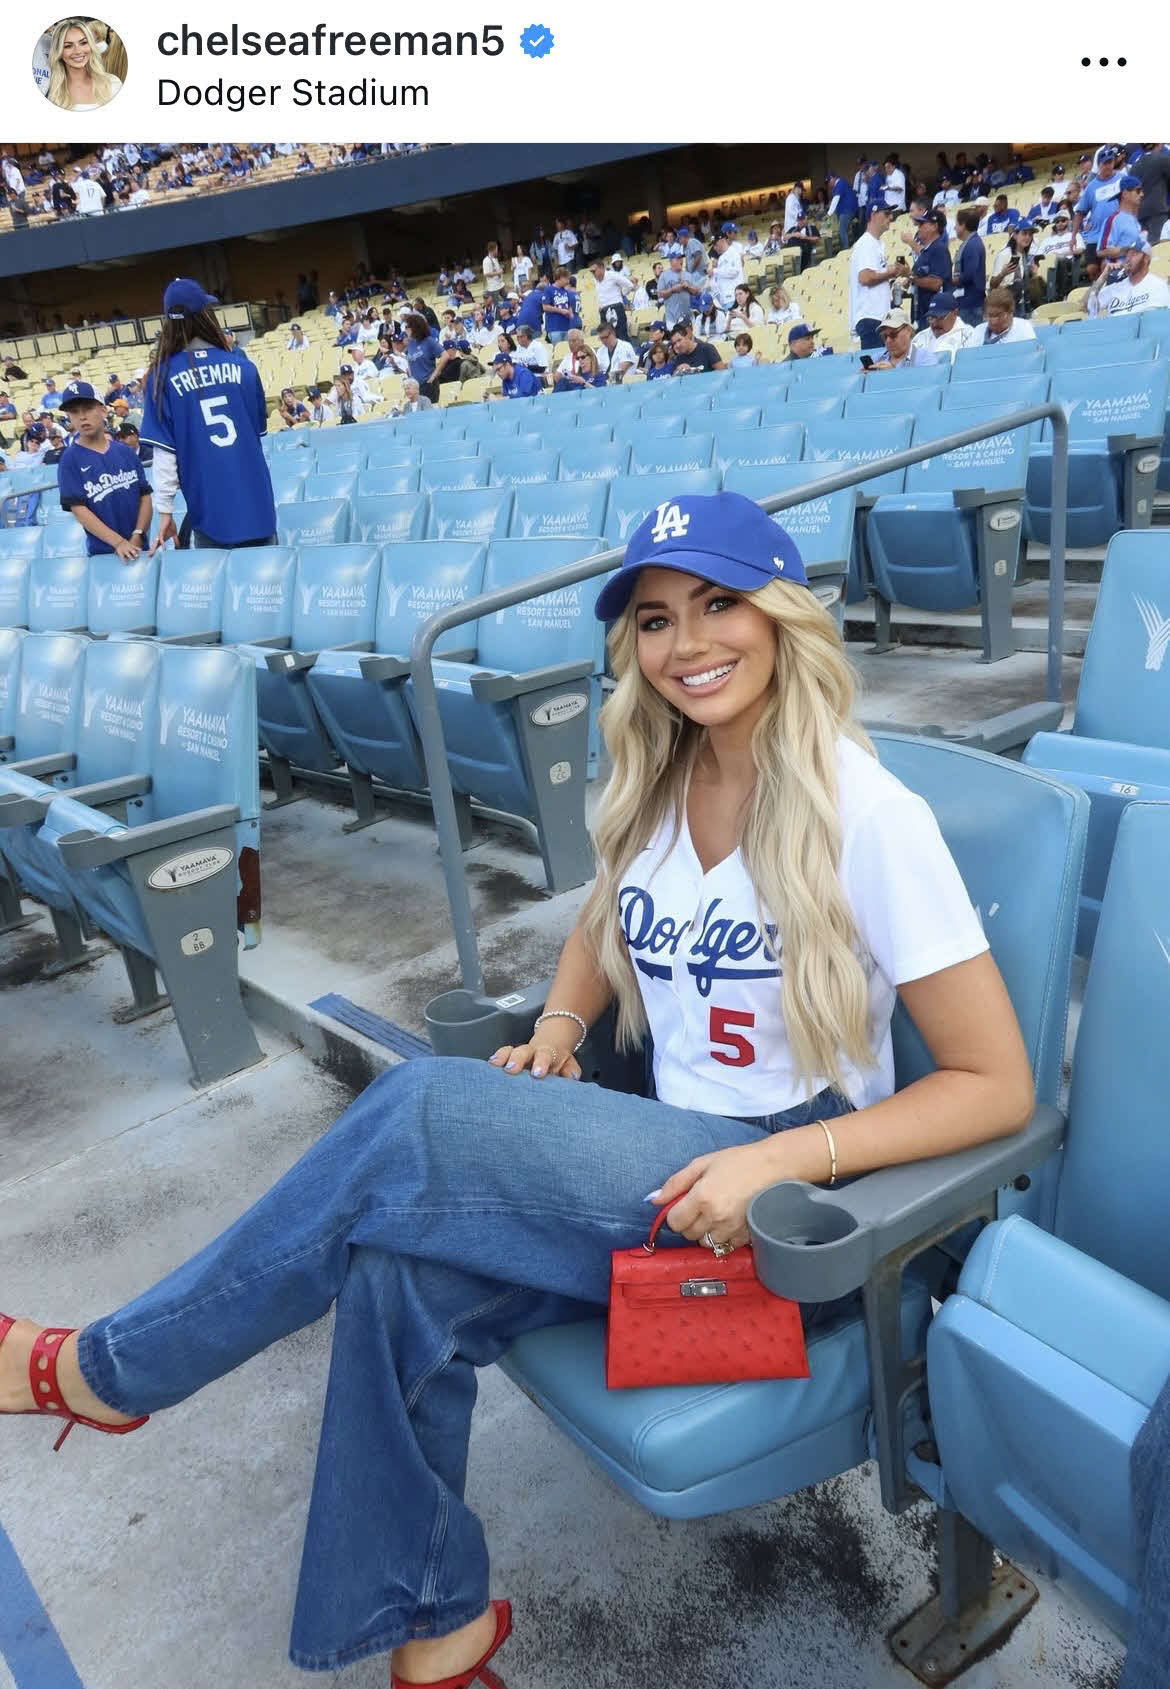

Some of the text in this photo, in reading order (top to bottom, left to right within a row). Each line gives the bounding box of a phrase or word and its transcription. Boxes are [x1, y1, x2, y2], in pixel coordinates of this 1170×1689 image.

[1110, 293, 1150, 312] Dodgers
[199, 395, 238, 448] 5
[651, 501, 691, 543] LA
[192, 932, 199, 942] 2
[618, 886, 783, 998] Dodger
[709, 1006, 756, 1068] 5
